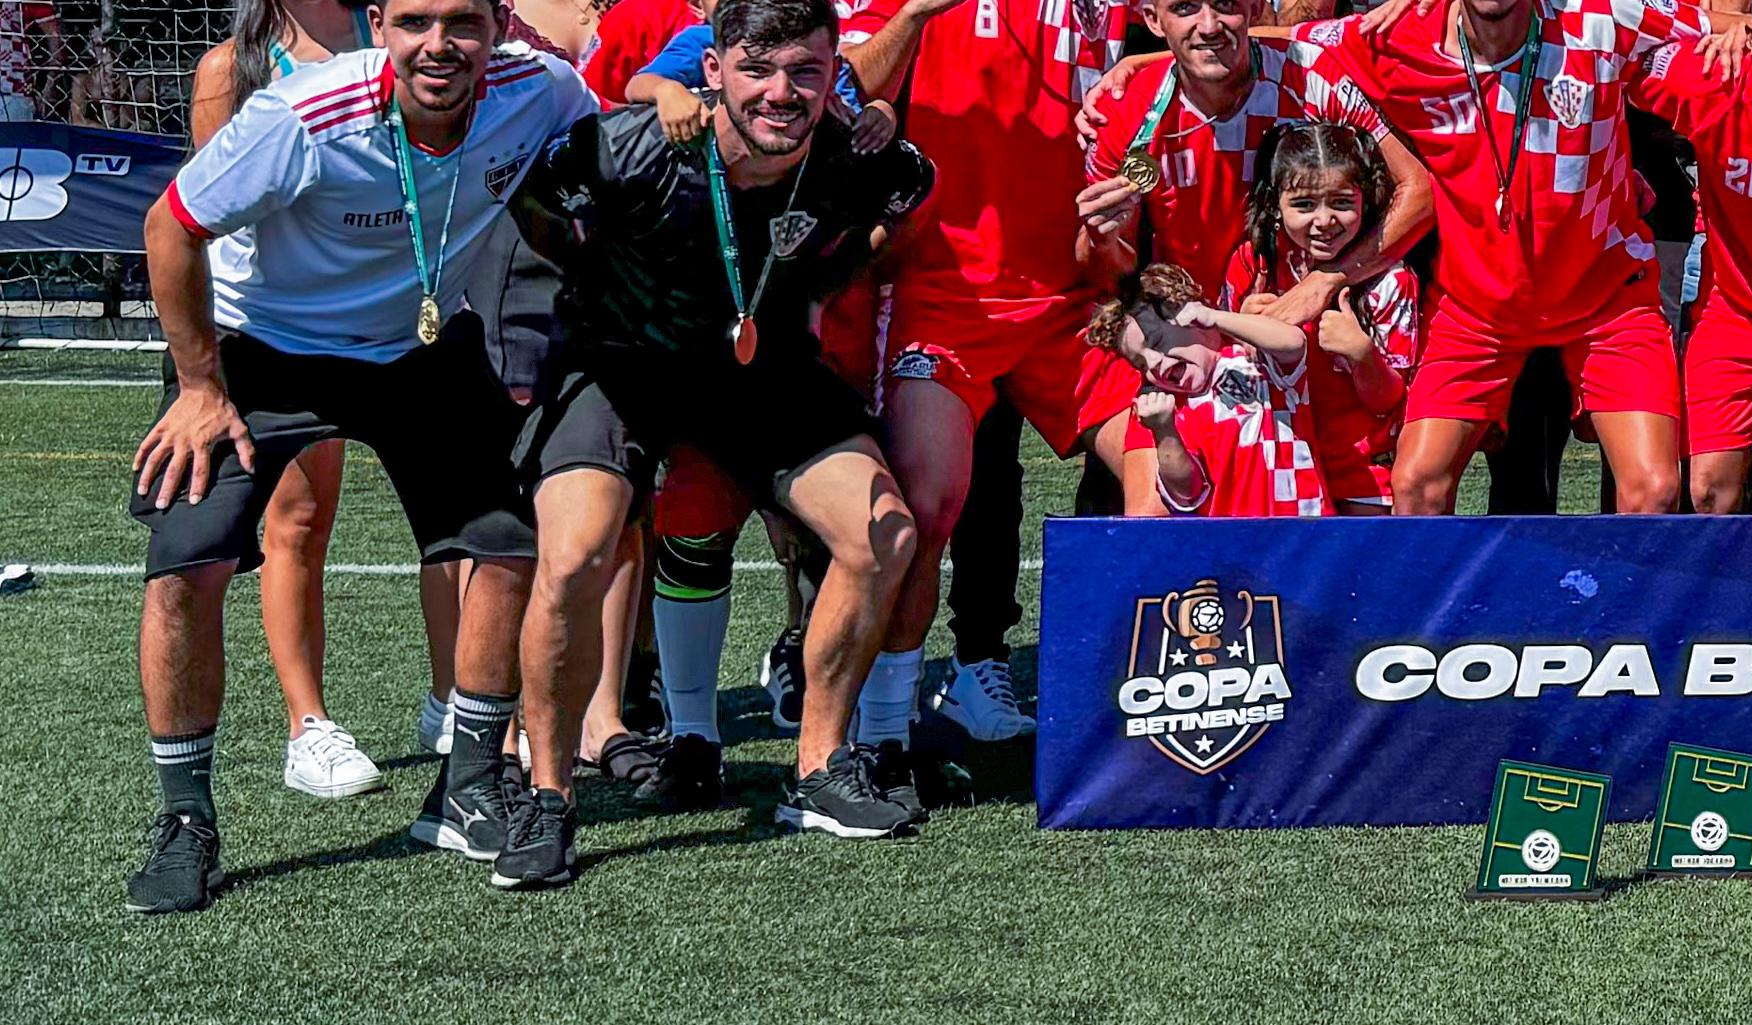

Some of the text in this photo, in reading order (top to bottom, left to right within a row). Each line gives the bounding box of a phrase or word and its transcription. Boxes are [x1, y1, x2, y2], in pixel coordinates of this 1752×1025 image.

[1420, 92, 1476, 134] 50
[81, 157, 127, 172] TV
[1161, 148, 1198, 188] 10
[344, 210, 403, 227] ATLETA
[1118, 664, 1293, 715] COPA
[1355, 644, 1661, 702] COPA
[1126, 703, 1285, 737] BETINENSE
